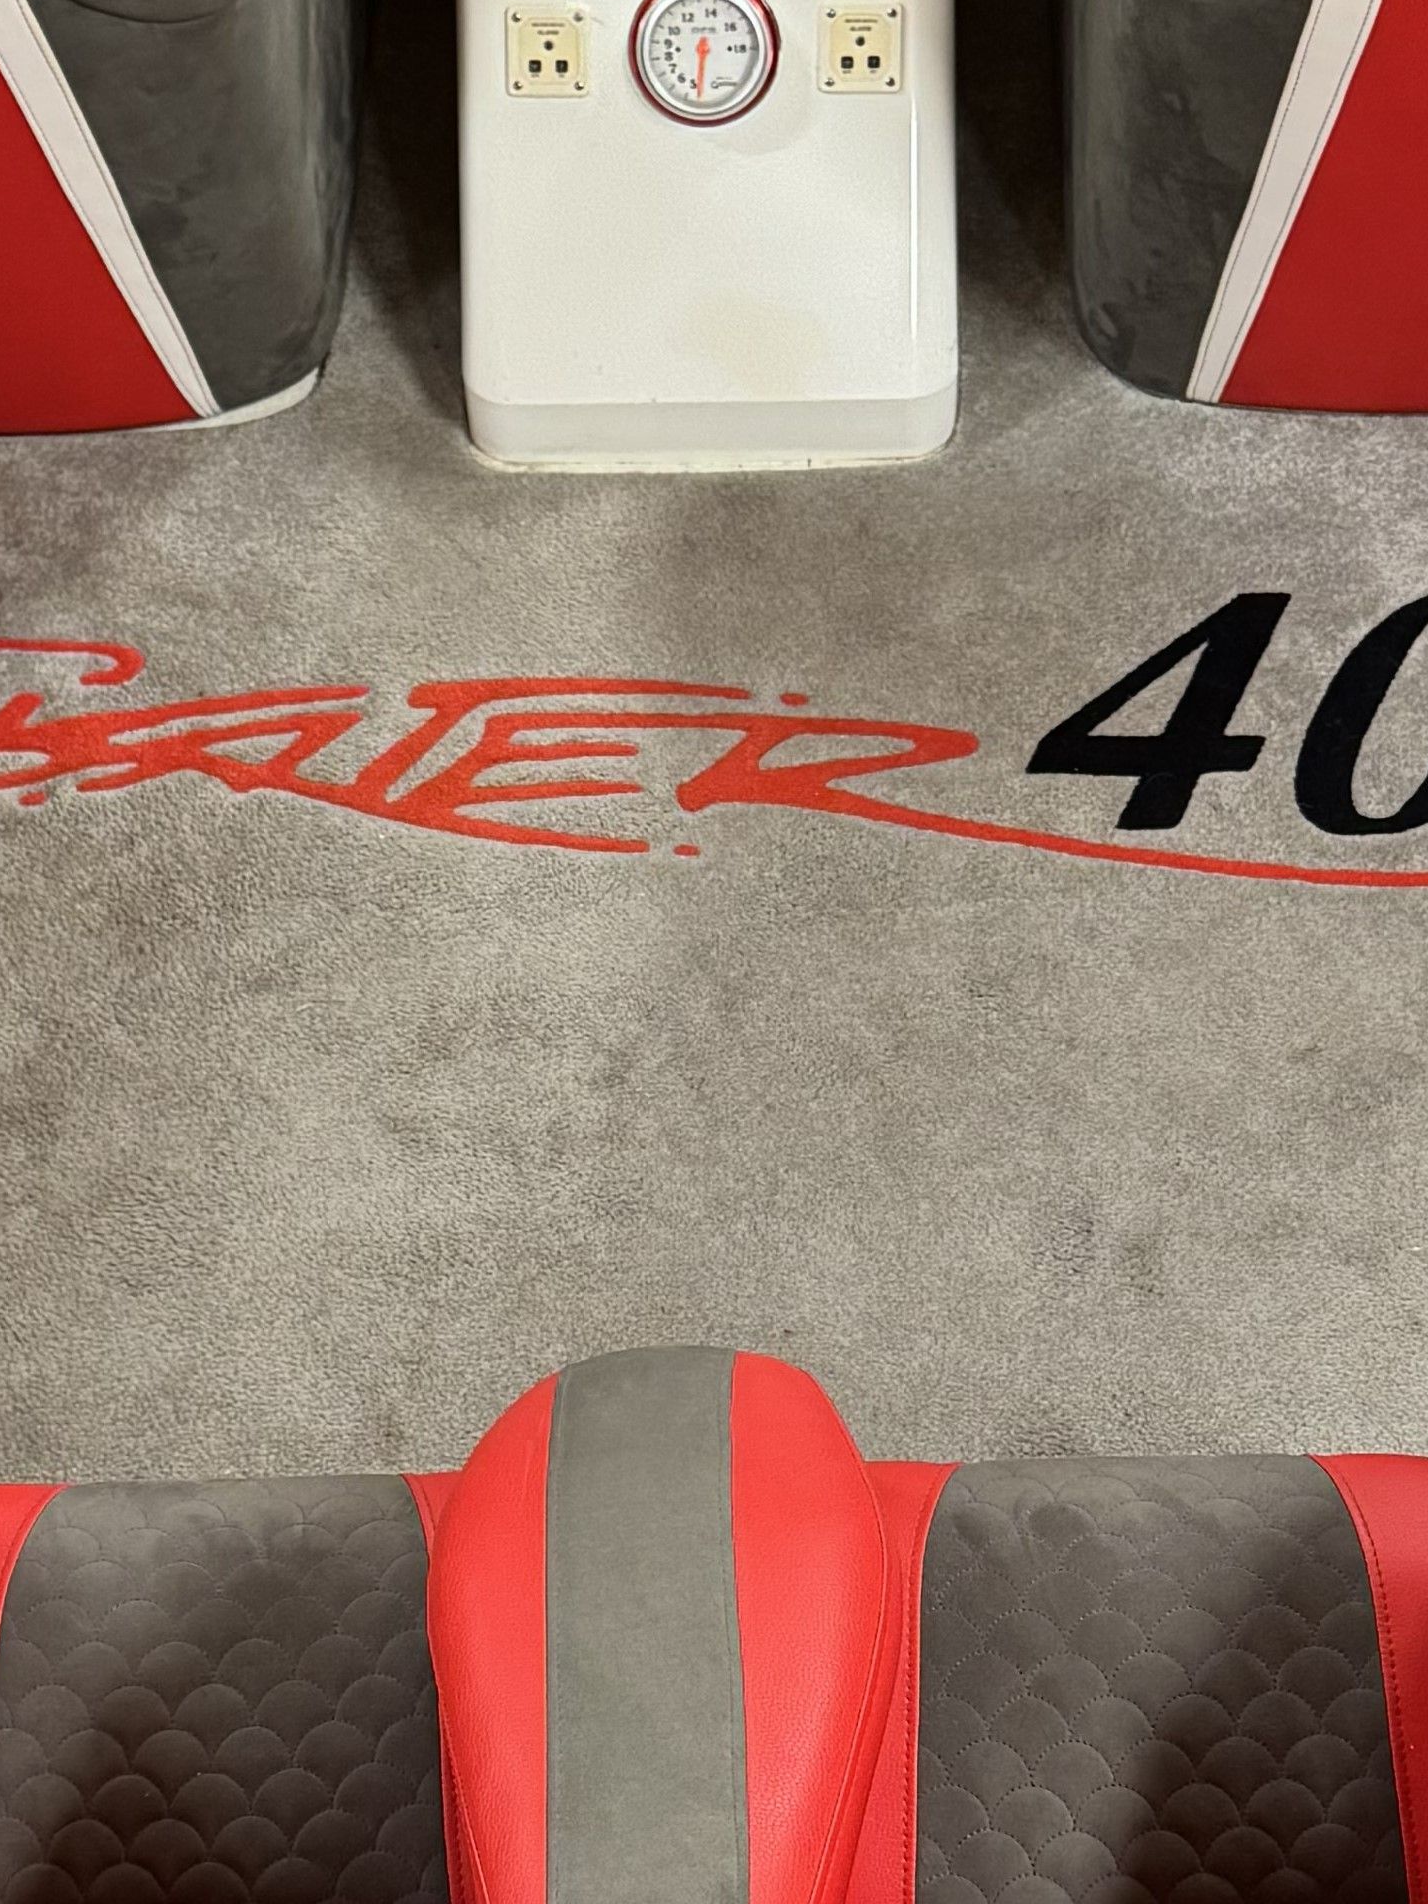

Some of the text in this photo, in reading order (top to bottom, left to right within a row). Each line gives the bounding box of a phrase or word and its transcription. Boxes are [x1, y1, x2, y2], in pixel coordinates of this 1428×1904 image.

[681, 13, 694, 22] 12
[705, 9, 717, 17] 14
[668, 27, 680, 35] 10
[724, 23, 736, 31] 16
[664, 39, 672, 48] 9
[735, 45, 746, 53] 18
[665, 52, 673, 61] 8
[669, 64, 676, 73] 7
[678, 74, 685, 83] 6
